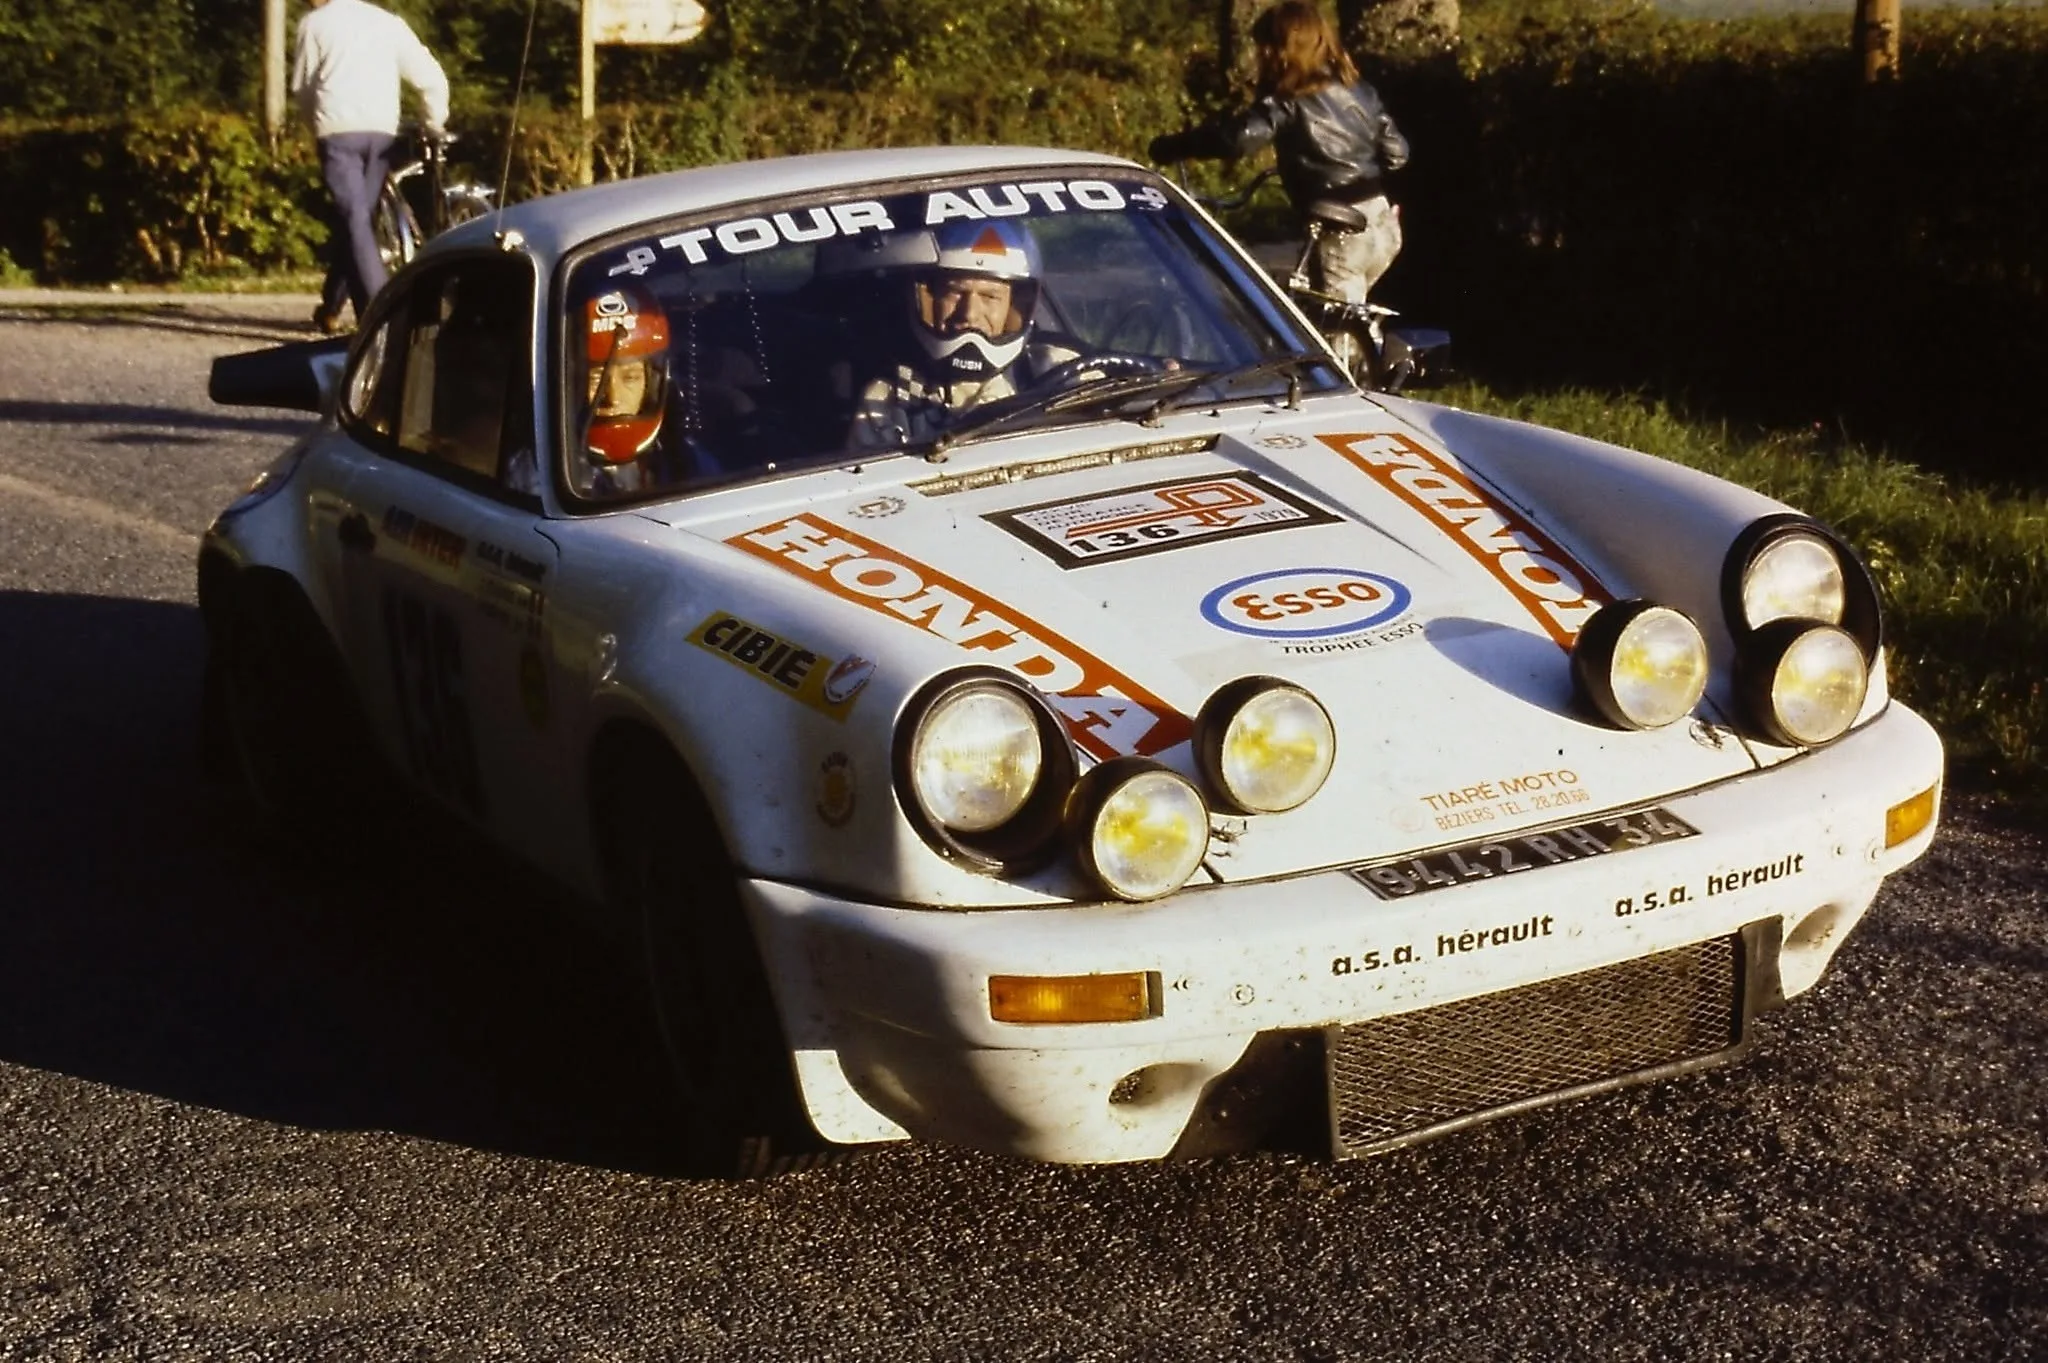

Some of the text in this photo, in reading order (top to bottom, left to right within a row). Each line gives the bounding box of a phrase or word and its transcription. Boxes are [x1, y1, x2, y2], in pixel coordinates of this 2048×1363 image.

[660, 181, 1128, 264] TOUR AUTO
[1069, 524, 1180, 552] 136
[1233, 582, 1381, 621] ESSO
[703, 618, 817, 690] CIBIE
[743, 517, 1160, 757] HONDA
[1380, 622, 1423, 642] ESSO
[1498, 769, 1578, 796] MOTO
[1369, 806, 1690, 895] 9442 RH 34
[1615, 885, 1693, 917] a.s.a.
[1331, 914, 1553, 976] a.s.a. hérault
